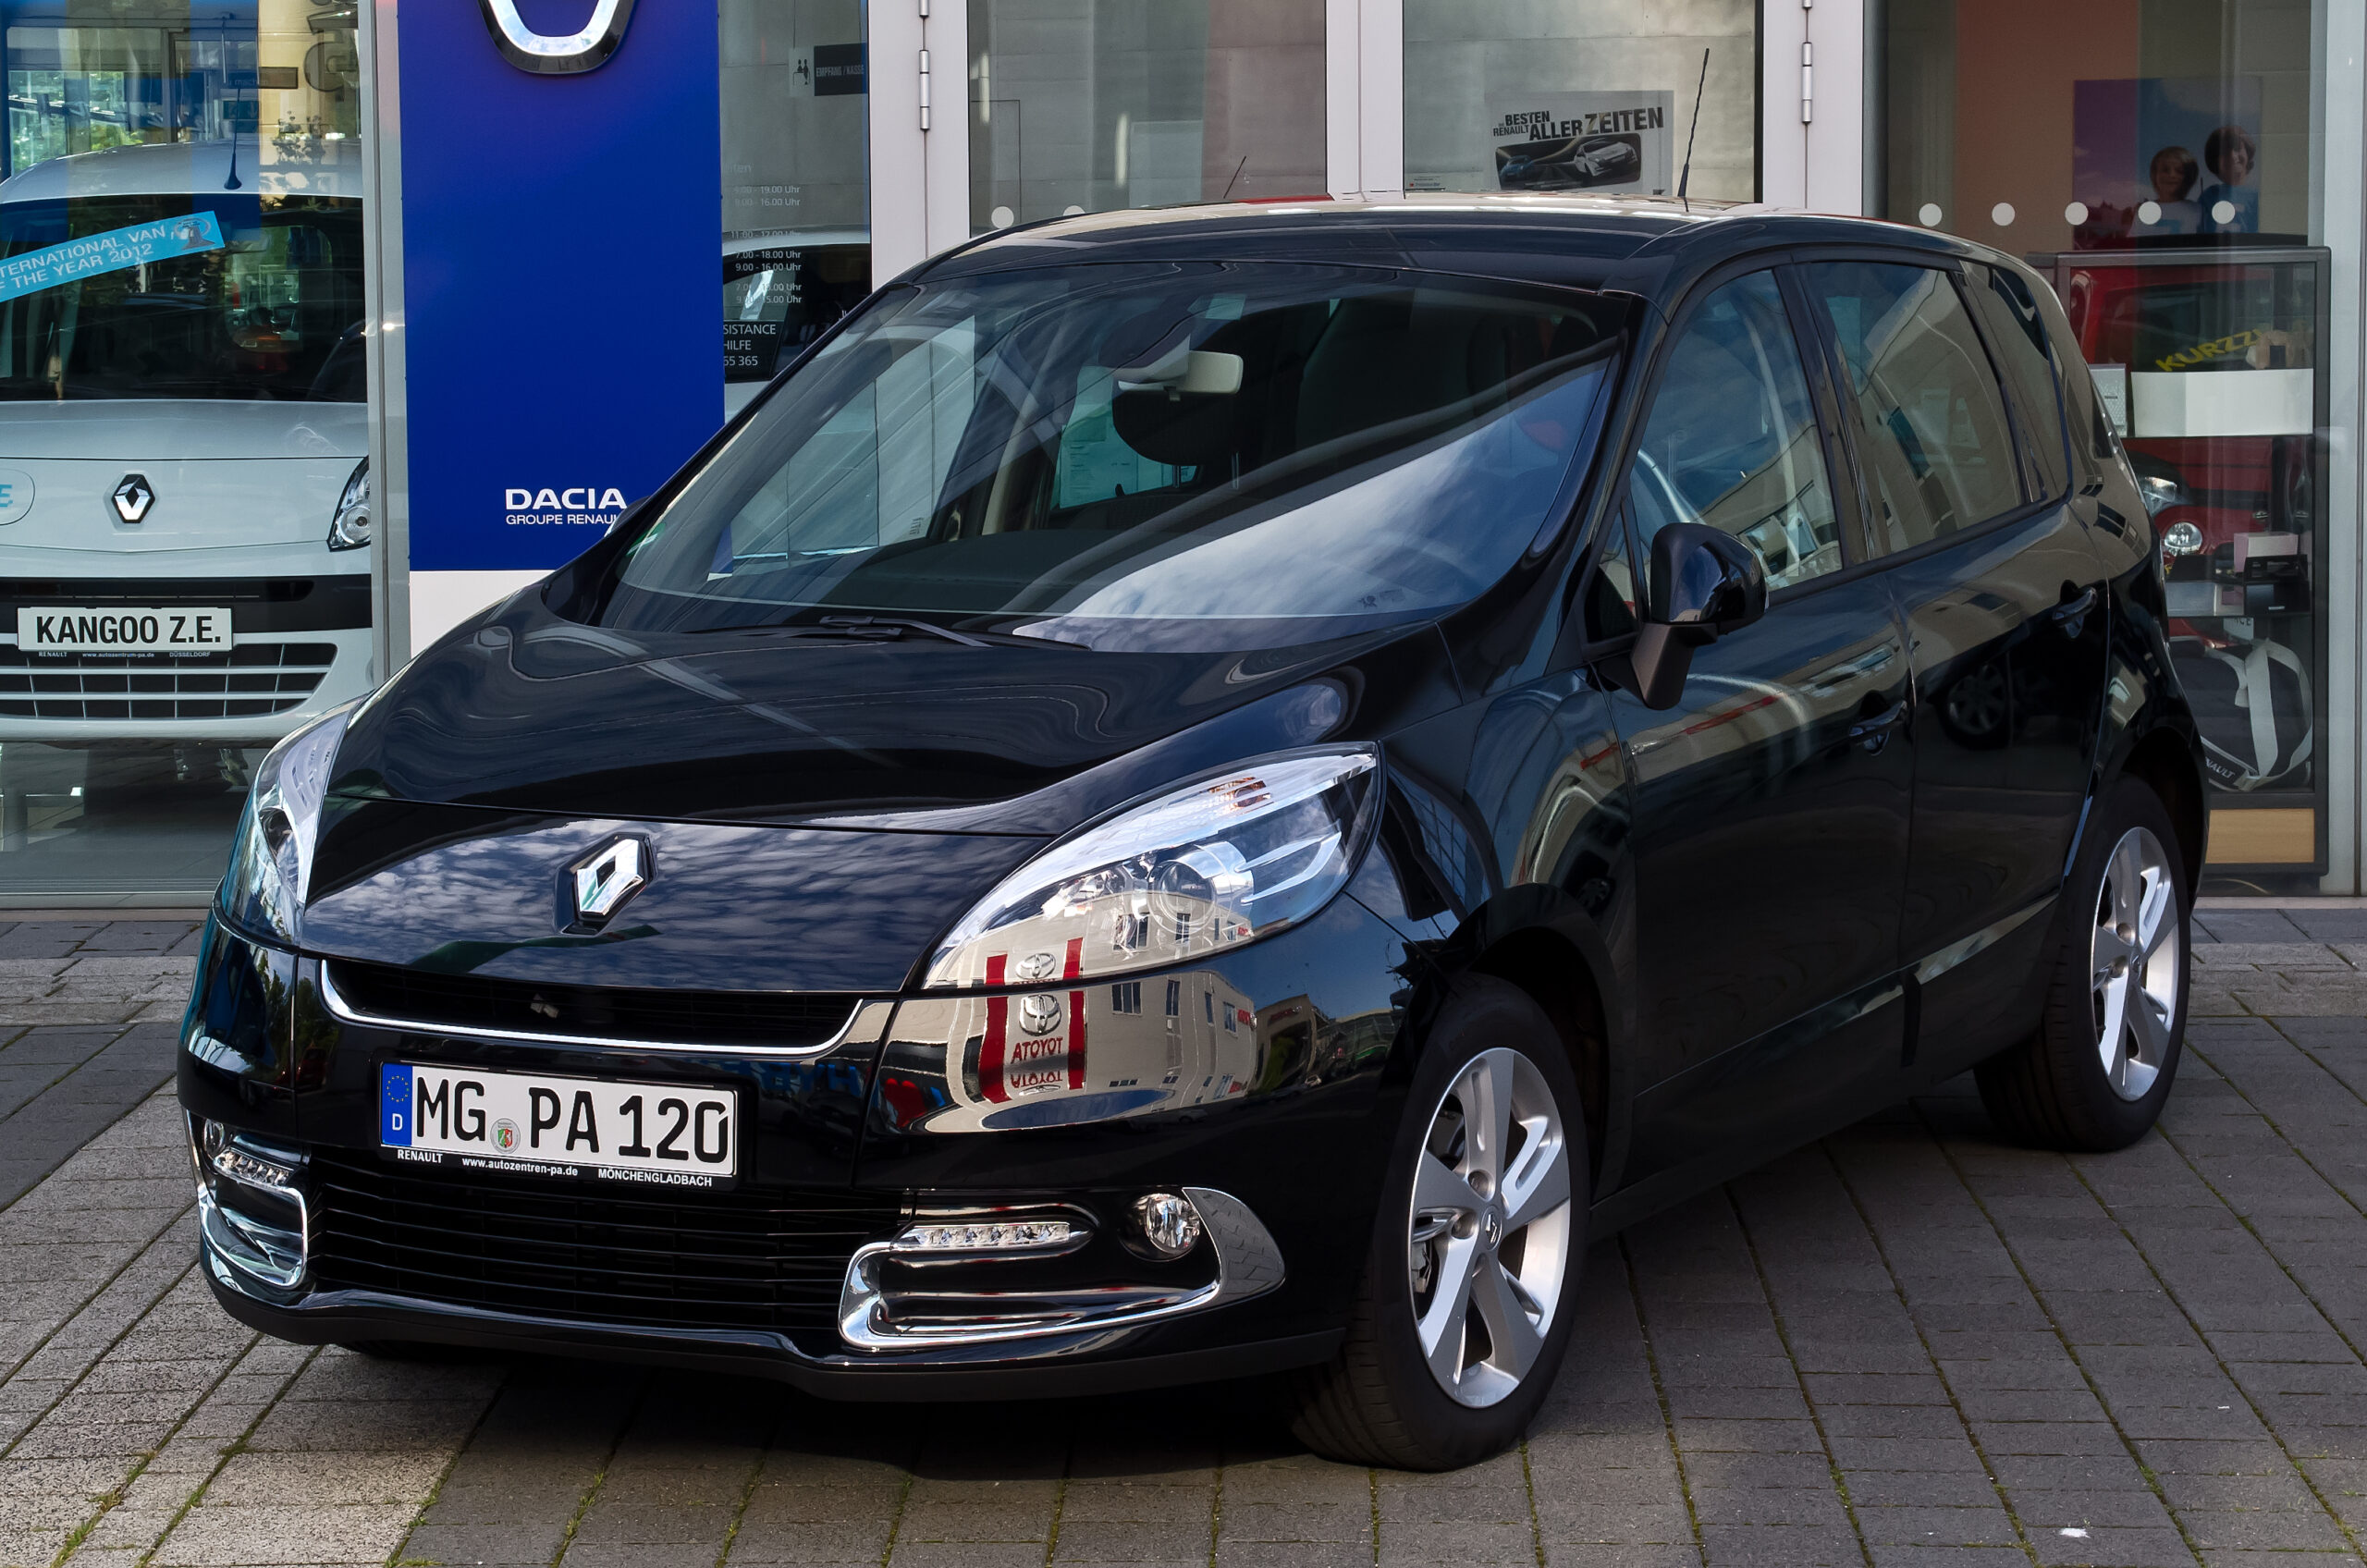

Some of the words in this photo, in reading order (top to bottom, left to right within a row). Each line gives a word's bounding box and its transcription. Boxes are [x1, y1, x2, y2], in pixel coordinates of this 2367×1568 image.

[1492, 124, 1531, 138] RENAULT
[1528, 119, 1584, 141] ALLER
[1584, 106, 1664, 135] ZEITEN
[1504, 110, 1551, 127] BESTEN
[760, 185, 783, 194] 19.00
[785, 185, 801, 194] Uhr
[761, 198, 783, 207] 16.00
[785, 198, 801, 207] Uhr
[128, 225, 166, 243] VAN
[761, 251, 784, 259] 18.00
[786, 250, 802, 259] Uhr
[10, 269, 49, 288] THE
[53, 255, 104, 276] YEAR
[108, 243, 153, 263] 2012
[735, 263, 754, 272] 9.00
[762, 263, 784, 272] 16.00
[786, 263, 802, 272] Uhr
[787, 282, 803, 292] Uhr
[787, 295, 803, 305] Uhr
[738, 355, 758, 366] 365
[505, 488, 627, 509] DACIA
[506, 514, 563, 525] GROUPE
[36, 616, 159, 643] KANGOO
[168, 616, 221, 643] Z.E.
[391, 1112, 404, 1131] D
[416, 1076, 486, 1142] MG
[529, 1087, 600, 1153] PA
[619, 1095, 729, 1164] 120
[397, 1149, 444, 1164] RENAULT
[461, 1157, 579, 1178] www.autozentren-pa.de
[597, 1165, 713, 1187] MÖNCHENGLADBACH
